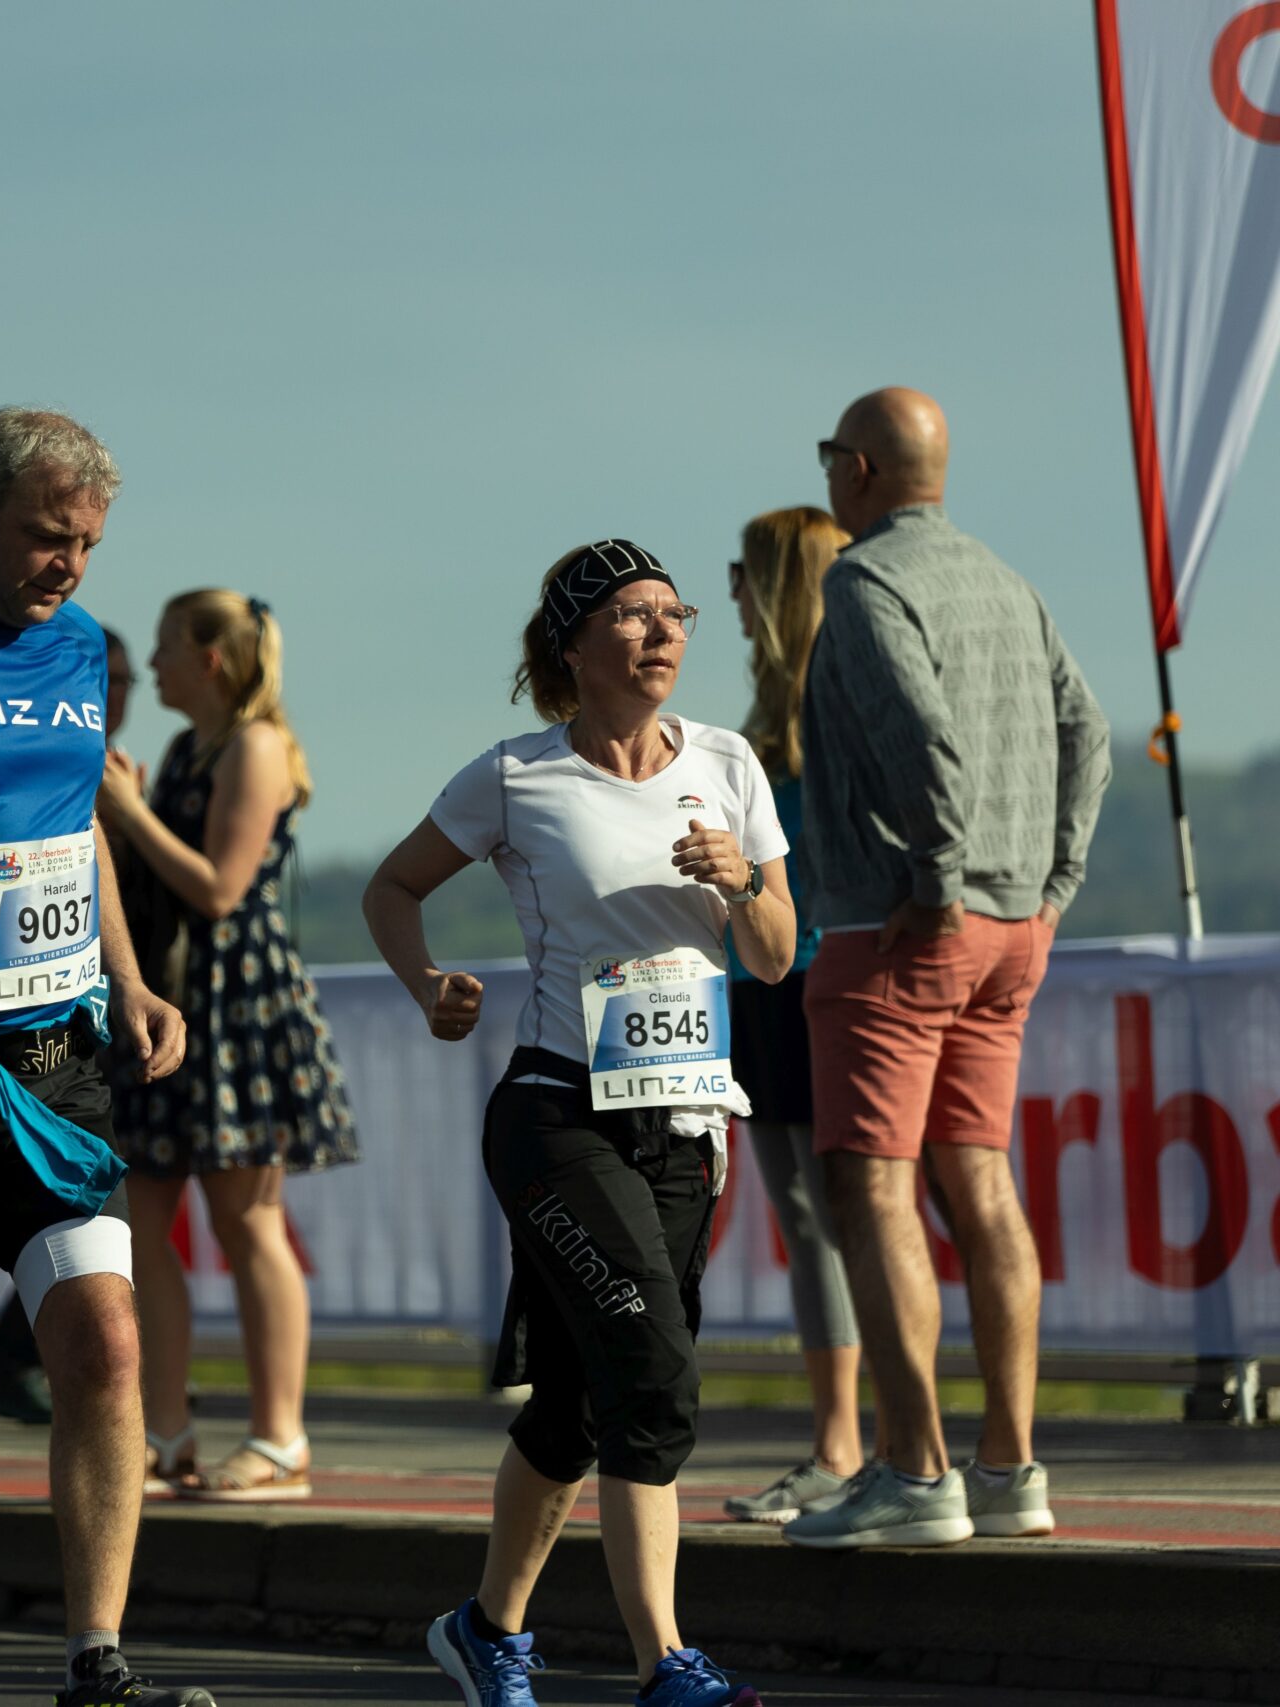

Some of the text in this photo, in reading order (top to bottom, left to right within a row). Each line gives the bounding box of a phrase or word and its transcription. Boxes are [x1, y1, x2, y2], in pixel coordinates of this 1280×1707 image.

[51, 701, 103, 732] AG
[29, 856, 73, 869] LIN DONAU
[43, 880, 77, 896] Harald
[18, 894, 92, 944] 9037
[76, 957, 96, 986] AG
[645, 959, 682, 968] Oberbank
[632, 975, 684, 983] MARATHON
[649, 992, 691, 1004] Claudia
[624, 1010, 709, 1047] 8545
[653, 1052, 717, 1064] VIERTELMARATHON
[603, 1075, 727, 1099] LINZ AG
